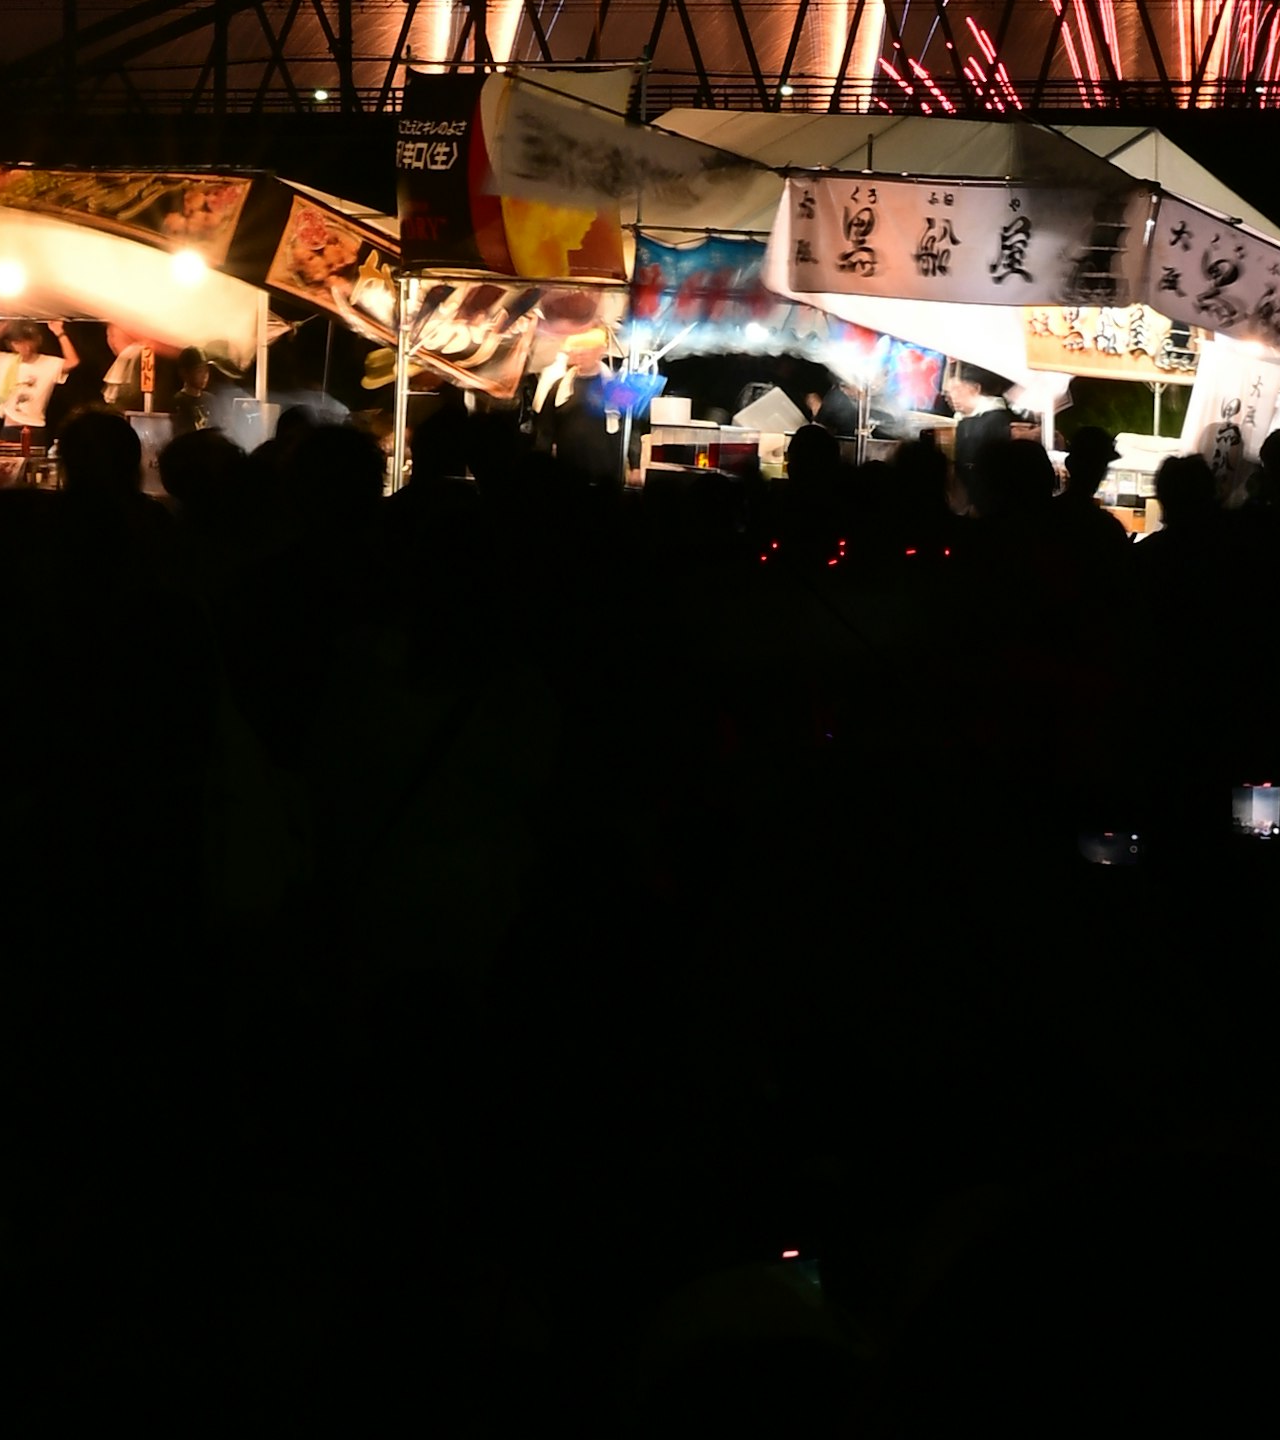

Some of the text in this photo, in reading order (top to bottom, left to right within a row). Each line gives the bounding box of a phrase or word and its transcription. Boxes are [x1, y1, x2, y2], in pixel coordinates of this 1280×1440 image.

[850, 186, 877, 204] くろ
[837, 206, 1033, 284] 黒船屋
